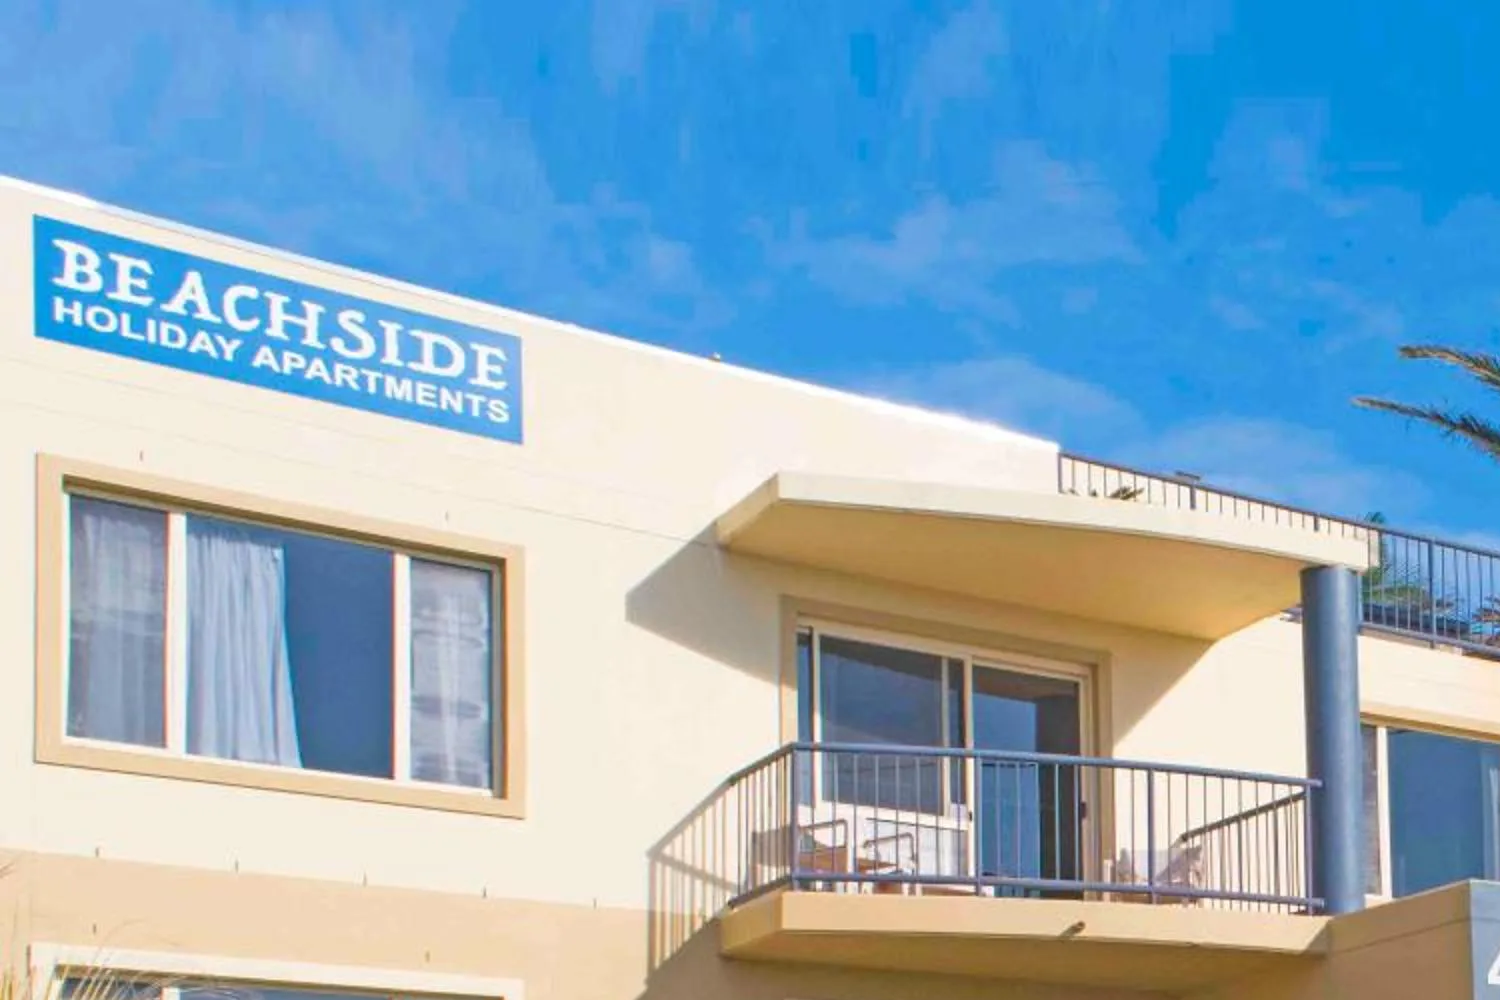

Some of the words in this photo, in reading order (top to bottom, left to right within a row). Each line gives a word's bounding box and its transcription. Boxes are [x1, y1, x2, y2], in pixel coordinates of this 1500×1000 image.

[52, 239, 508, 390] BEACHSIDE
[53, 297, 242, 361] HOLIDAY
[252, 346, 511, 423] APARTMENTS
